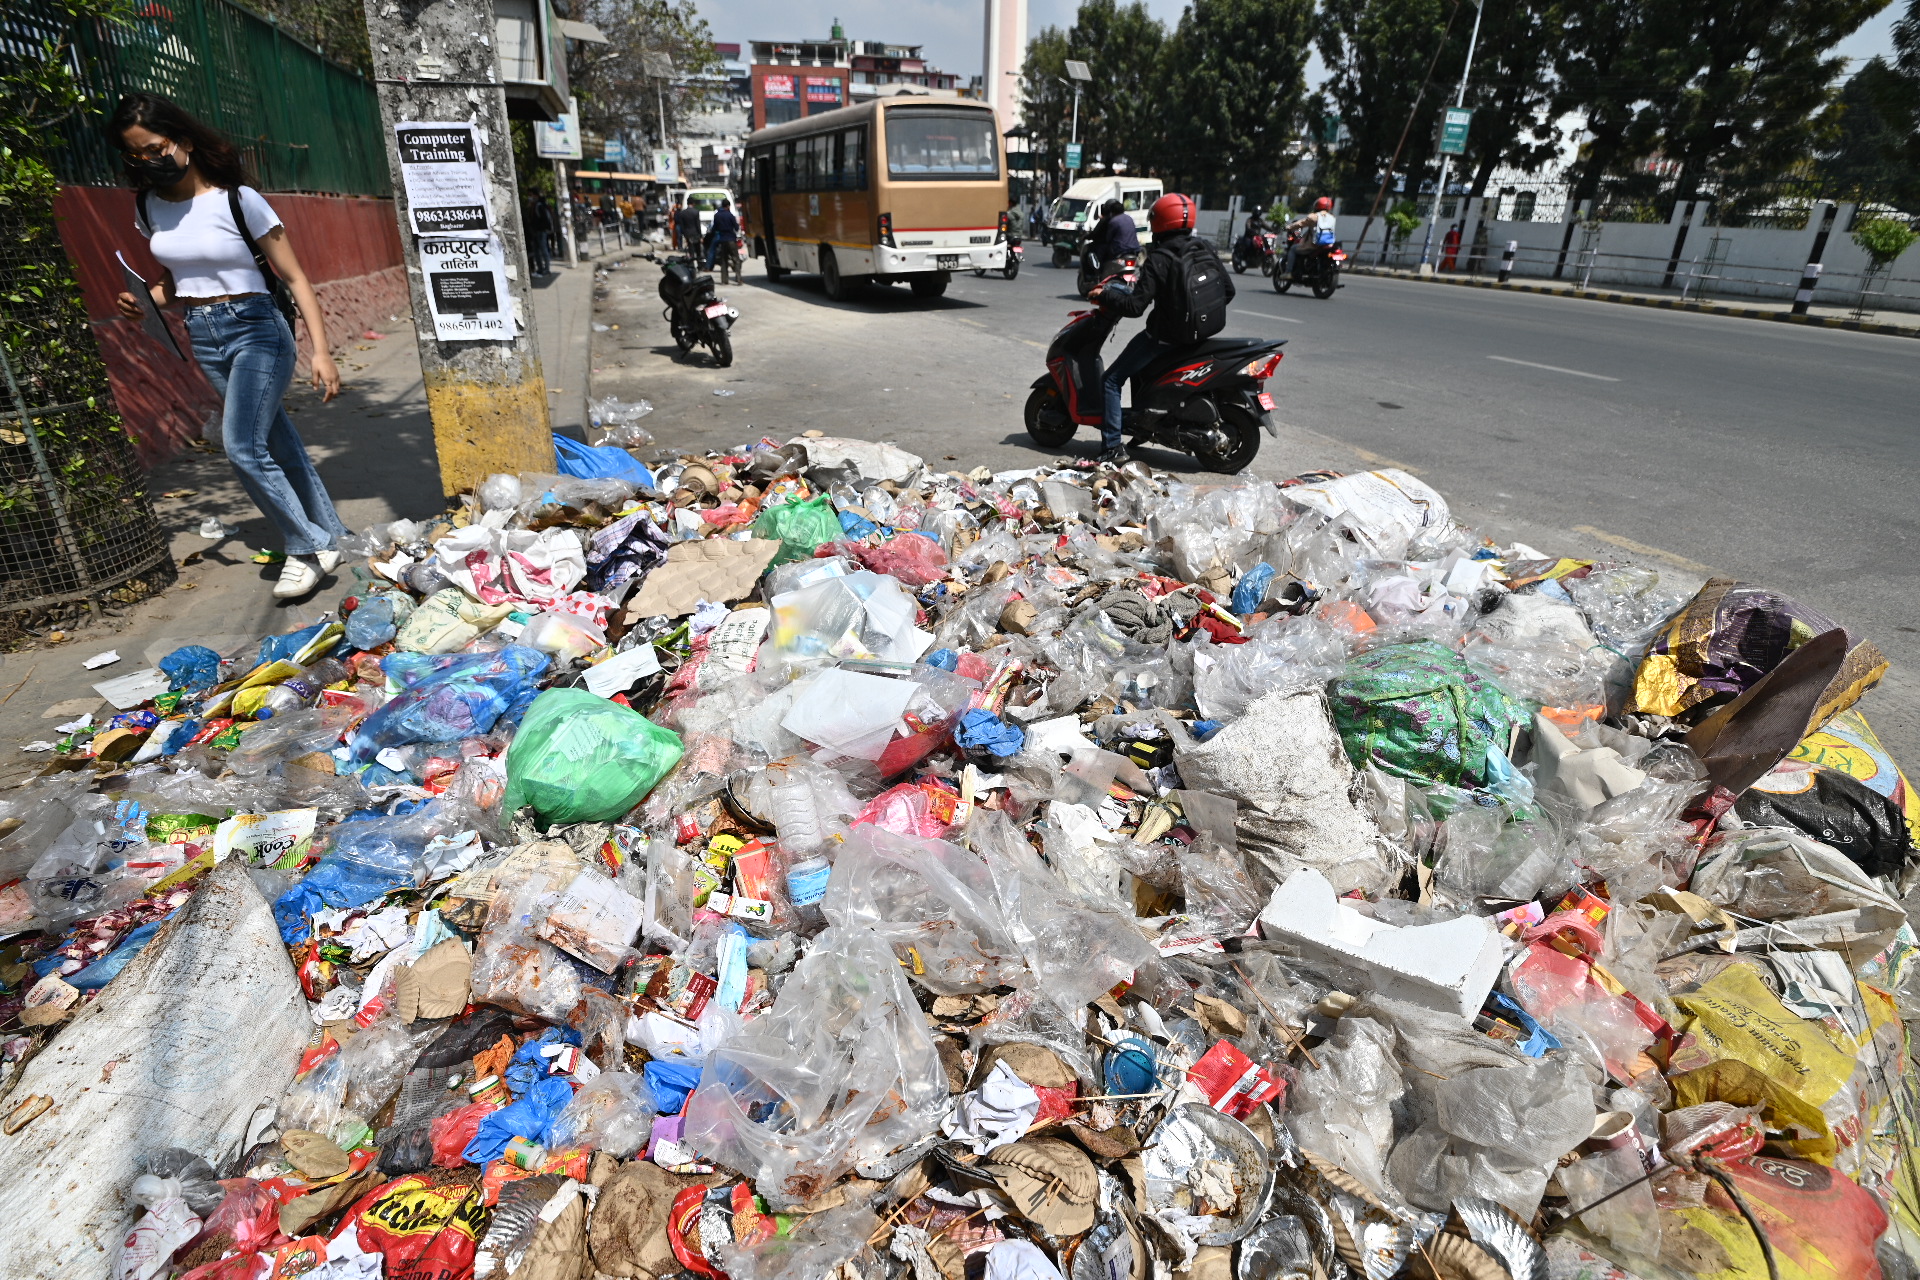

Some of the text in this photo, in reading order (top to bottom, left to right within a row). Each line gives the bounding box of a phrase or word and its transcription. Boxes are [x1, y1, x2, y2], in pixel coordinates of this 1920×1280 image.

[404, 133, 466, 148] Computer
[409, 147, 467, 163] Training
[416, 208, 484, 223] 9863438644
[440, 257, 479, 270] तालिम
[439, 319, 504, 331] 9865071402
[252, 836, 296, 859] Cook
[1699, 995, 1811, 1076] Premium Quality
